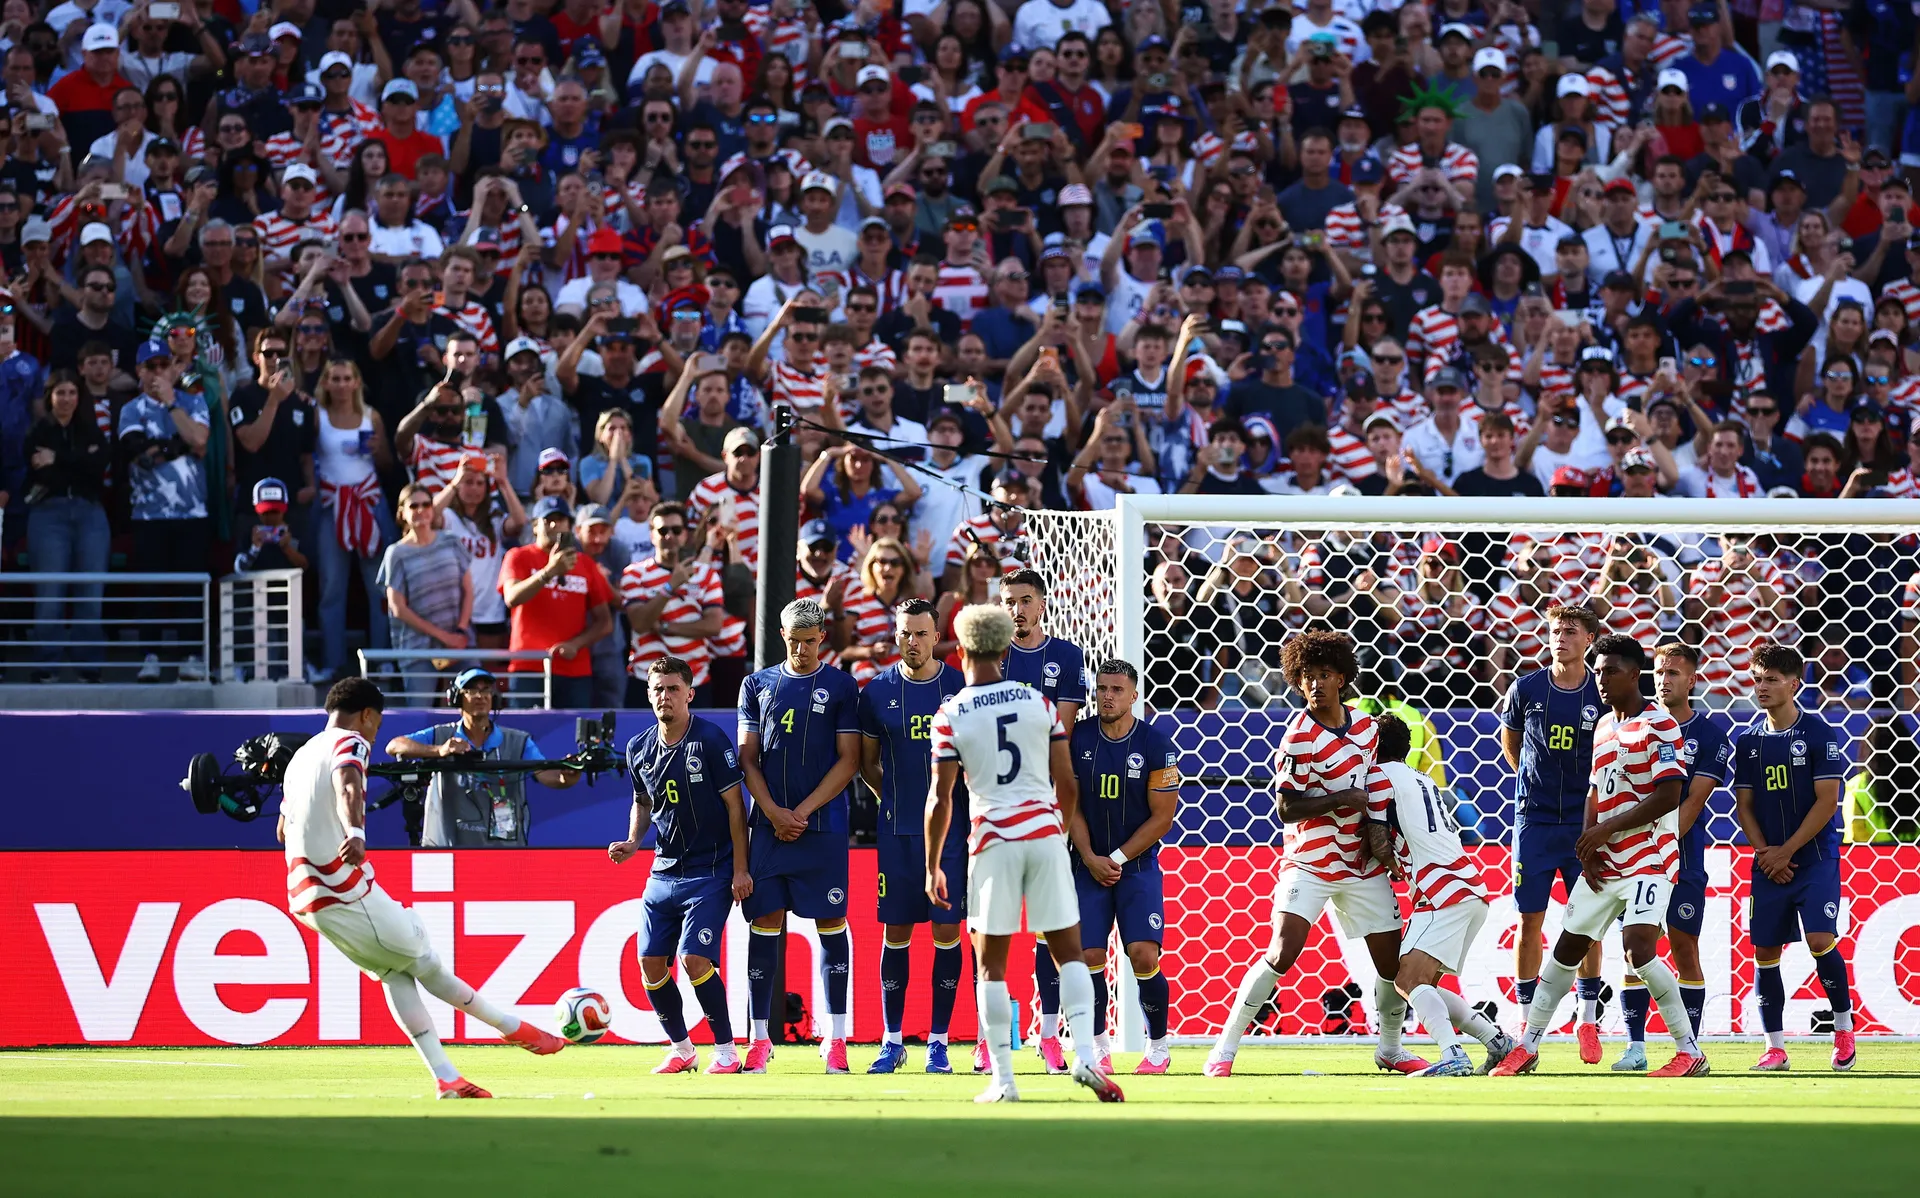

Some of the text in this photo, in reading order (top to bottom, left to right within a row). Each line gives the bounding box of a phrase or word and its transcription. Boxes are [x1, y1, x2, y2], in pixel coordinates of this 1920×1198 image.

[810, 249, 843, 266] SA
[958, 688, 1032, 717] A. ROBINSON
[780, 708, 794, 733] 4
[910, 714, 933, 740] 23
[996, 712, 1022, 785] 5
[1549, 724, 1575, 750] 26
[1099, 773, 1119, 799] 10
[1765, 764, 1788, 791] 20
[665, 779, 679, 804] 6
[1634, 881, 1658, 906] 16
